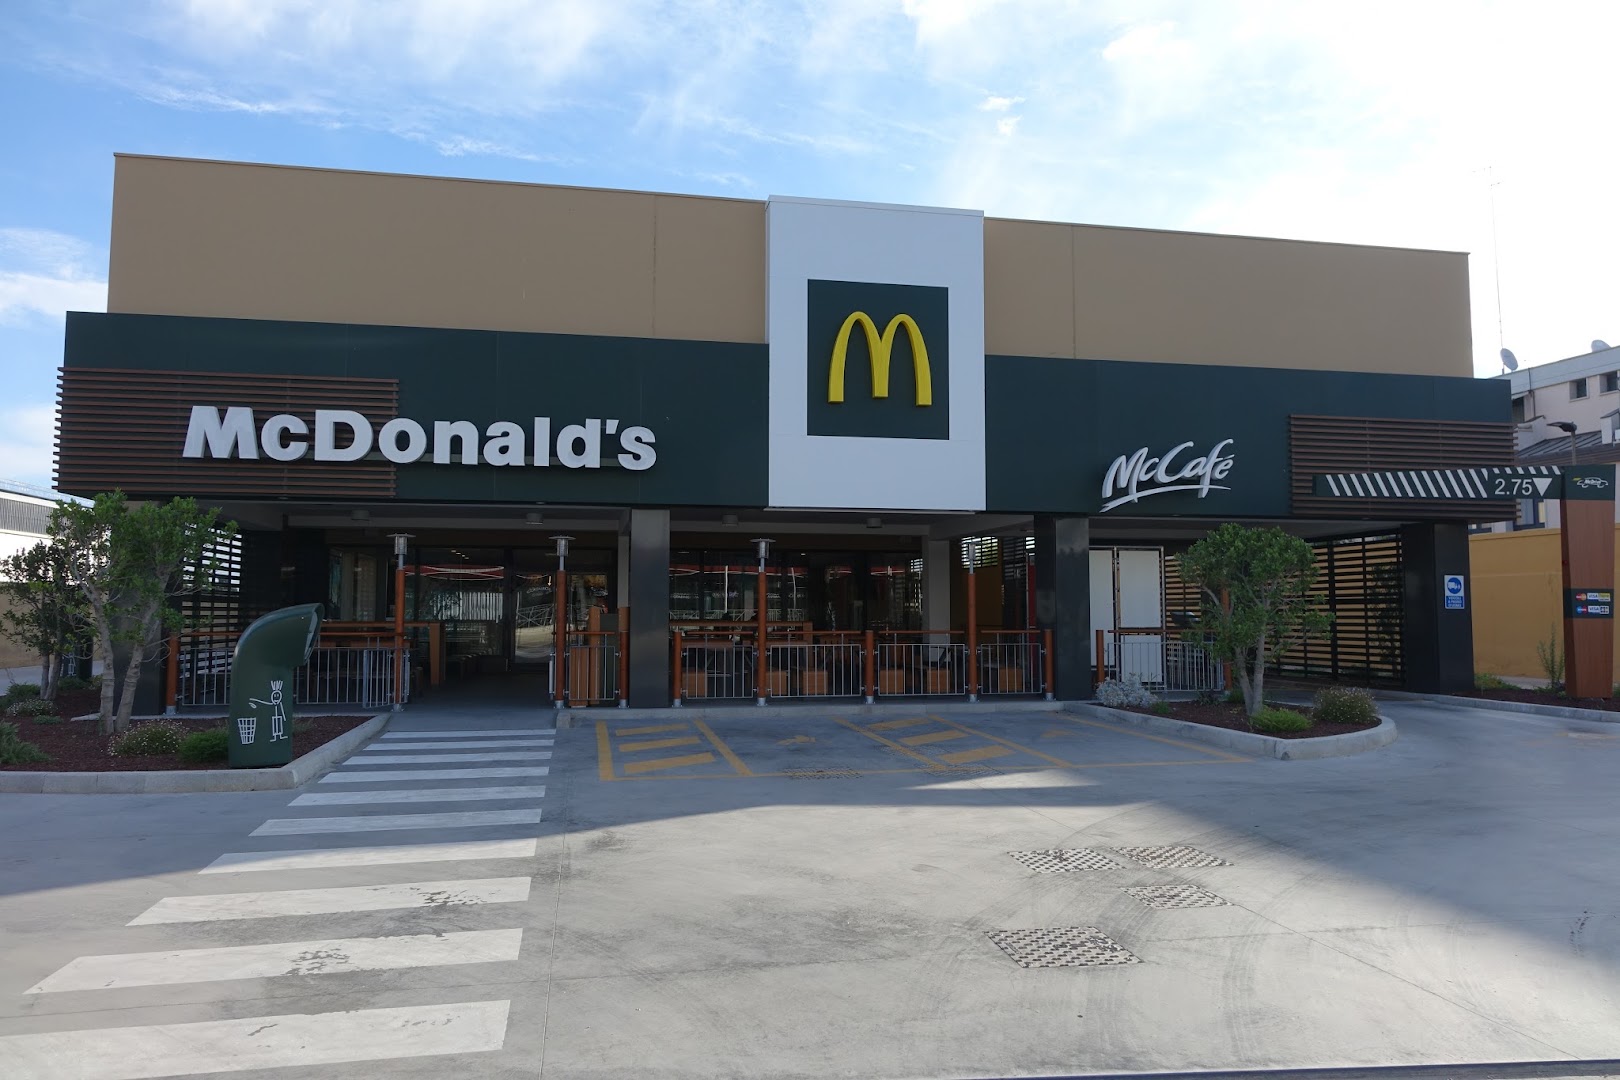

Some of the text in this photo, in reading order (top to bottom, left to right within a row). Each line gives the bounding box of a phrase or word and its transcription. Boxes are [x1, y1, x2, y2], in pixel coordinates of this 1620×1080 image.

[182, 405, 657, 471] McDonald's
[1101, 438, 1235, 503] McCafé
[1495, 478, 1532, 495] 2.75
